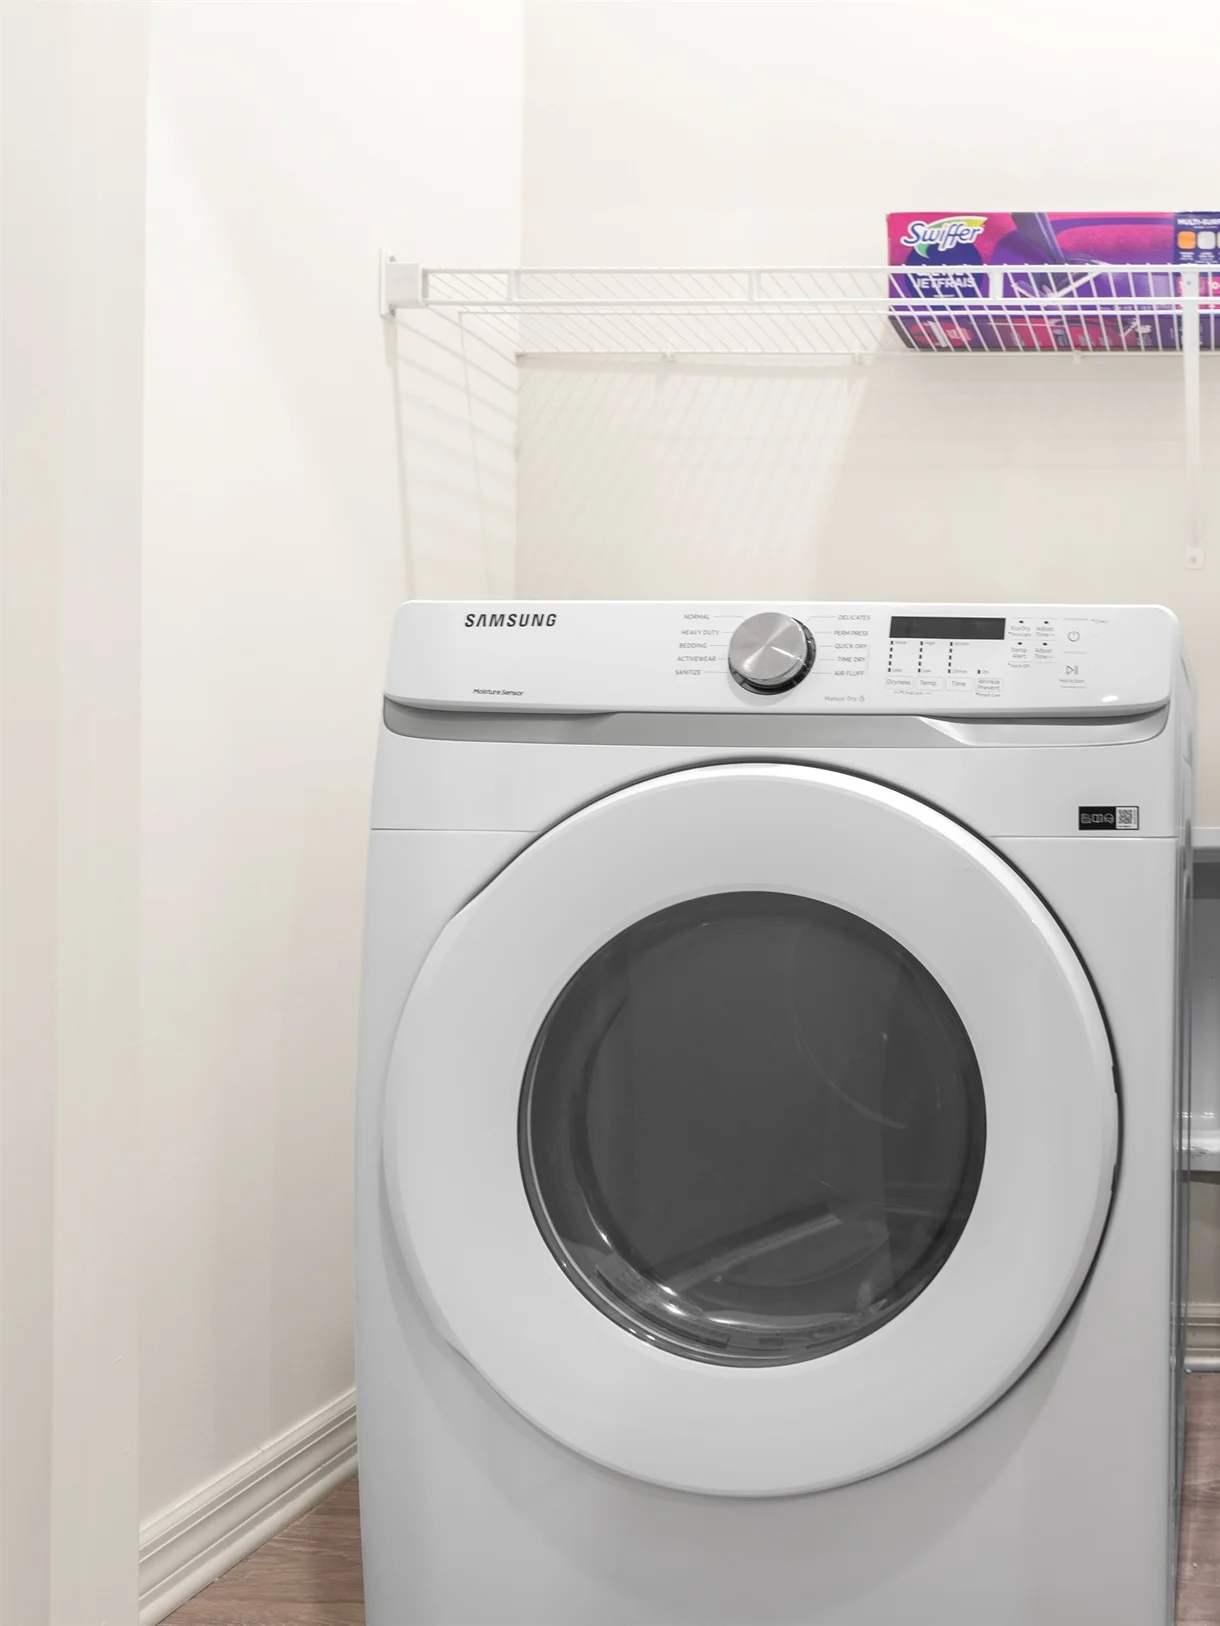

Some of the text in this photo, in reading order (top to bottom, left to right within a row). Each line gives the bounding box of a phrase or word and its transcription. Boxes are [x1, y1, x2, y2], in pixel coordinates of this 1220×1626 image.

[902, 221, 983, 251] Swiffer
[464, 613, 558, 628] SAMSUNG
[473, 688, 524, 697] Moisture Sensor
